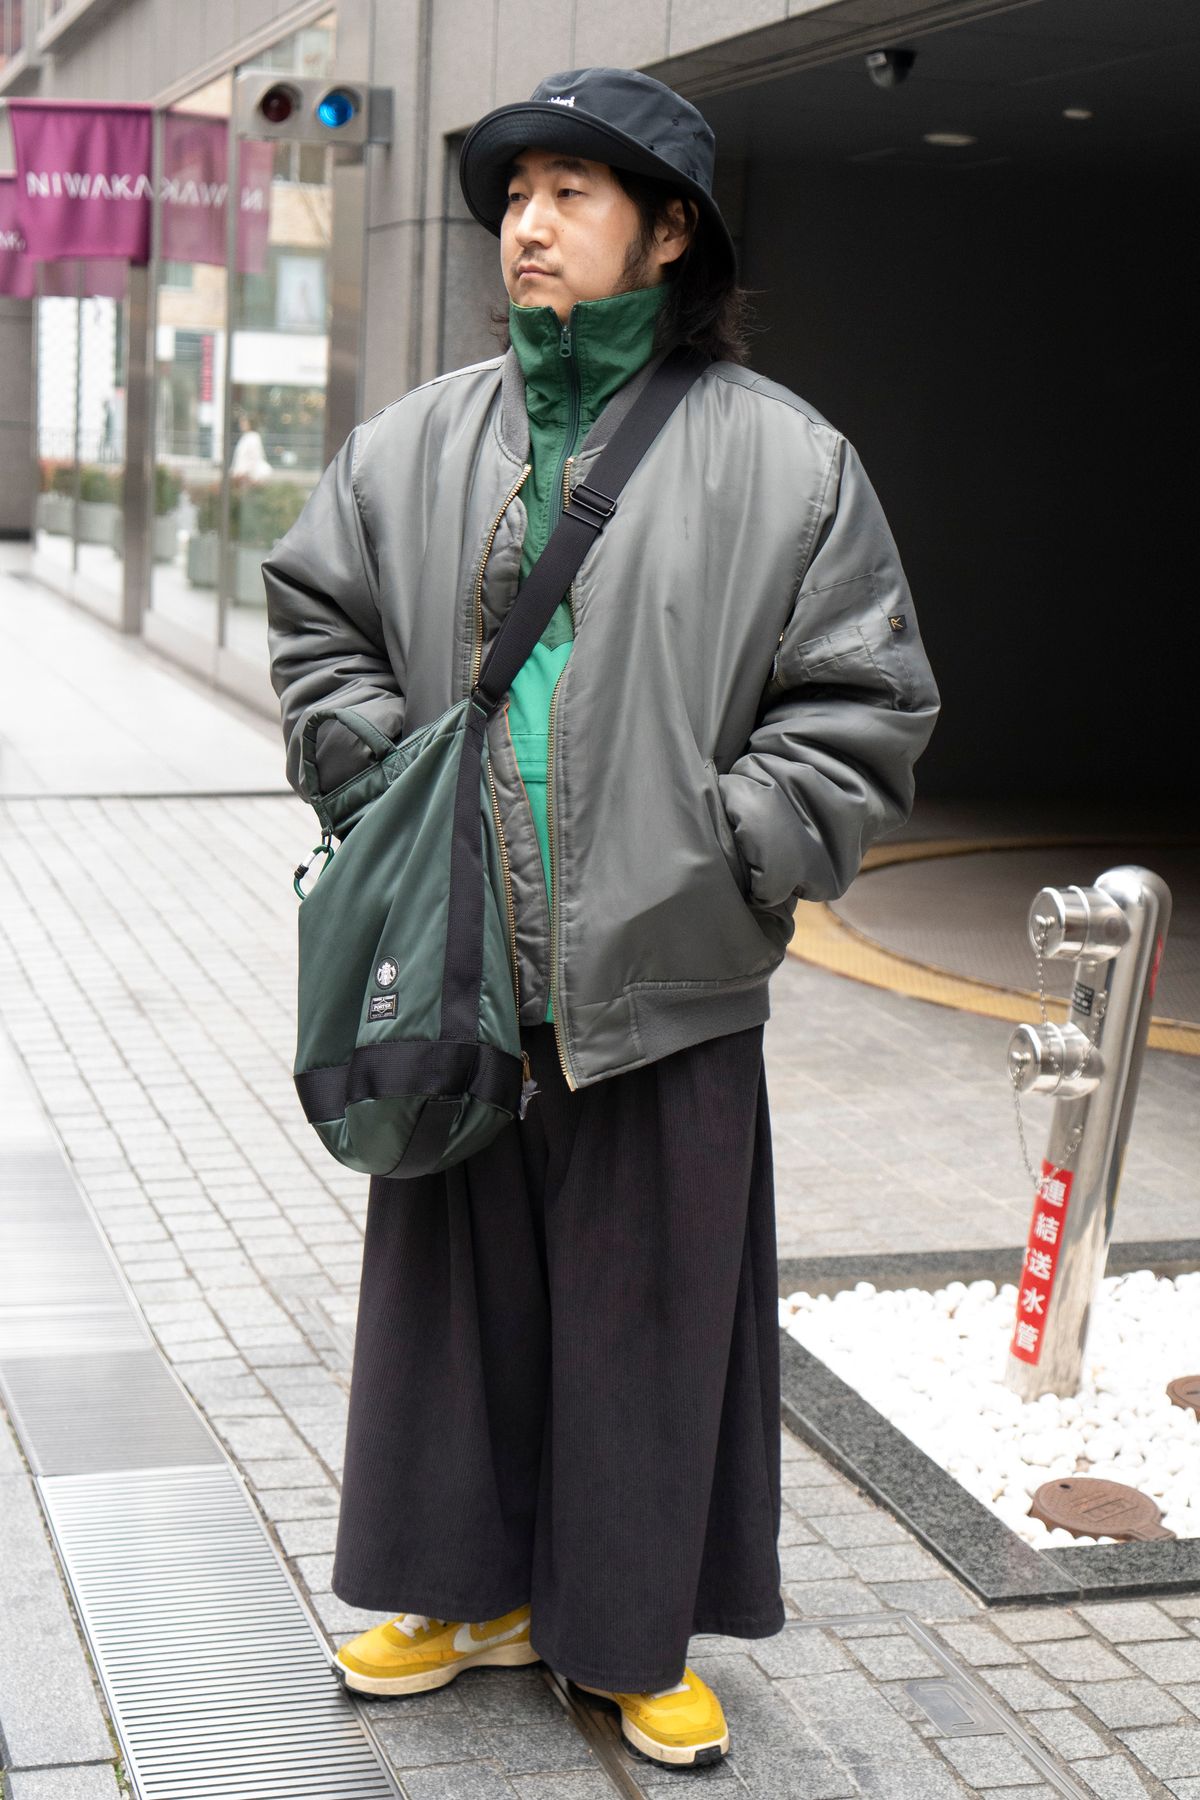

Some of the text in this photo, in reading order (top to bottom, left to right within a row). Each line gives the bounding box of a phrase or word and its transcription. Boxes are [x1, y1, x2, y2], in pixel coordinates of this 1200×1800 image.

[26, 171, 153, 201] NIWAKA
[1015, 1175, 1067, 1354] 連結送水管
